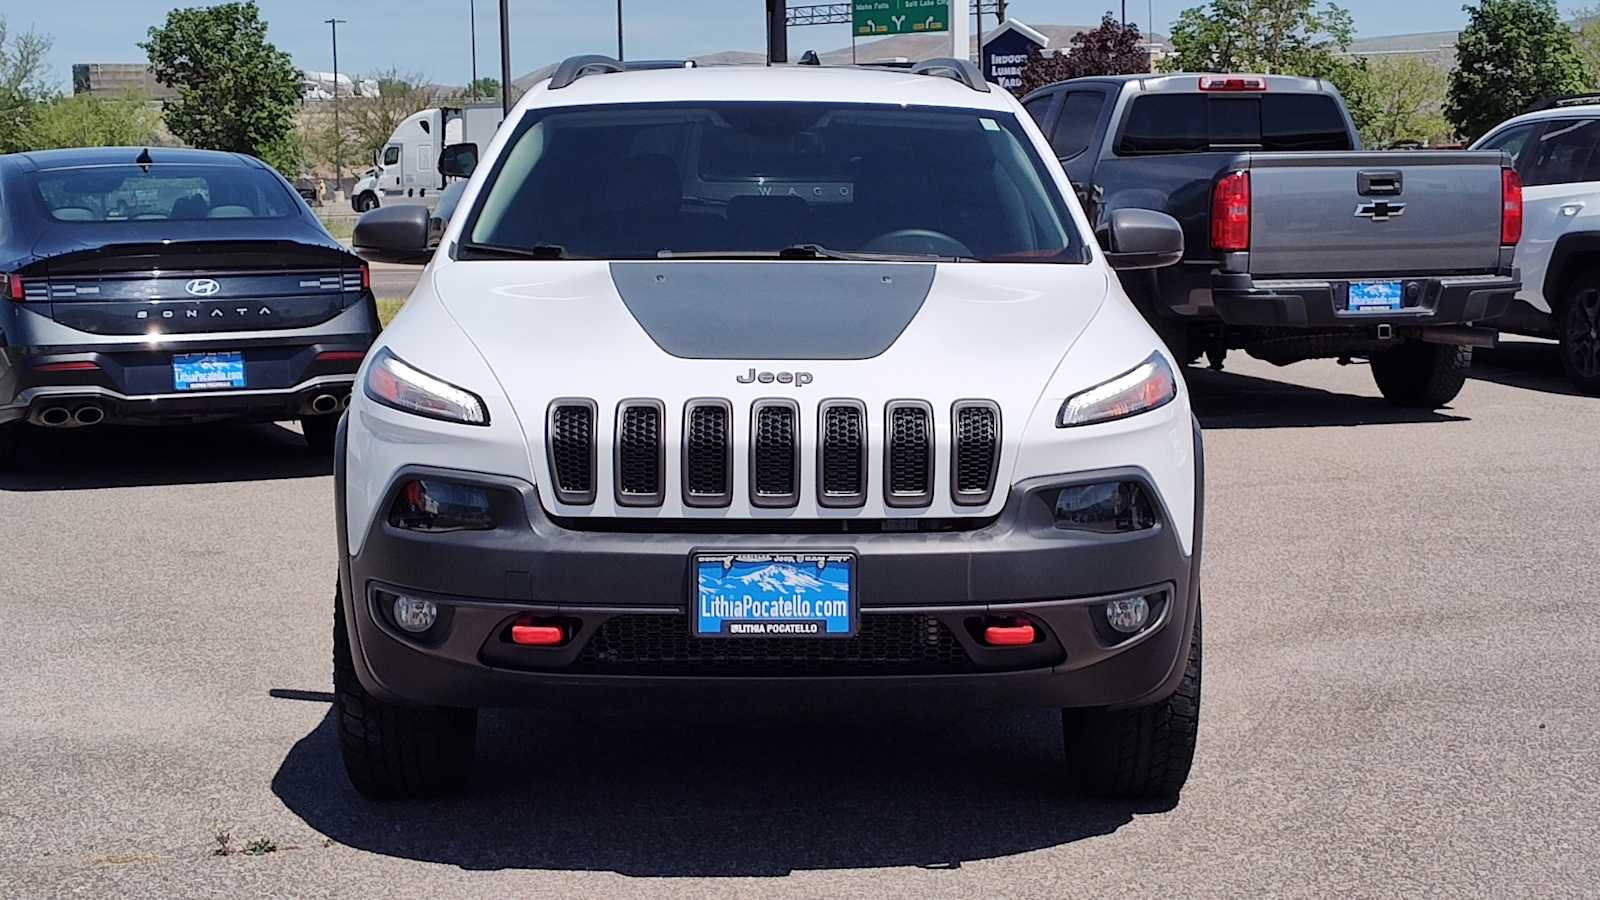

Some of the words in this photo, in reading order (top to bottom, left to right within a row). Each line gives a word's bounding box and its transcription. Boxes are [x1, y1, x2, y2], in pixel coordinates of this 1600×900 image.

[991, 66, 1022, 76] LUMB
[136, 306, 271, 318] SONATA
[736, 368, 813, 387] Jeep
[702, 595, 847, 618] LithiaPocatello.com
[738, 624, 765, 634] LITHIA
[766, 624, 818, 634] POCATELLO
